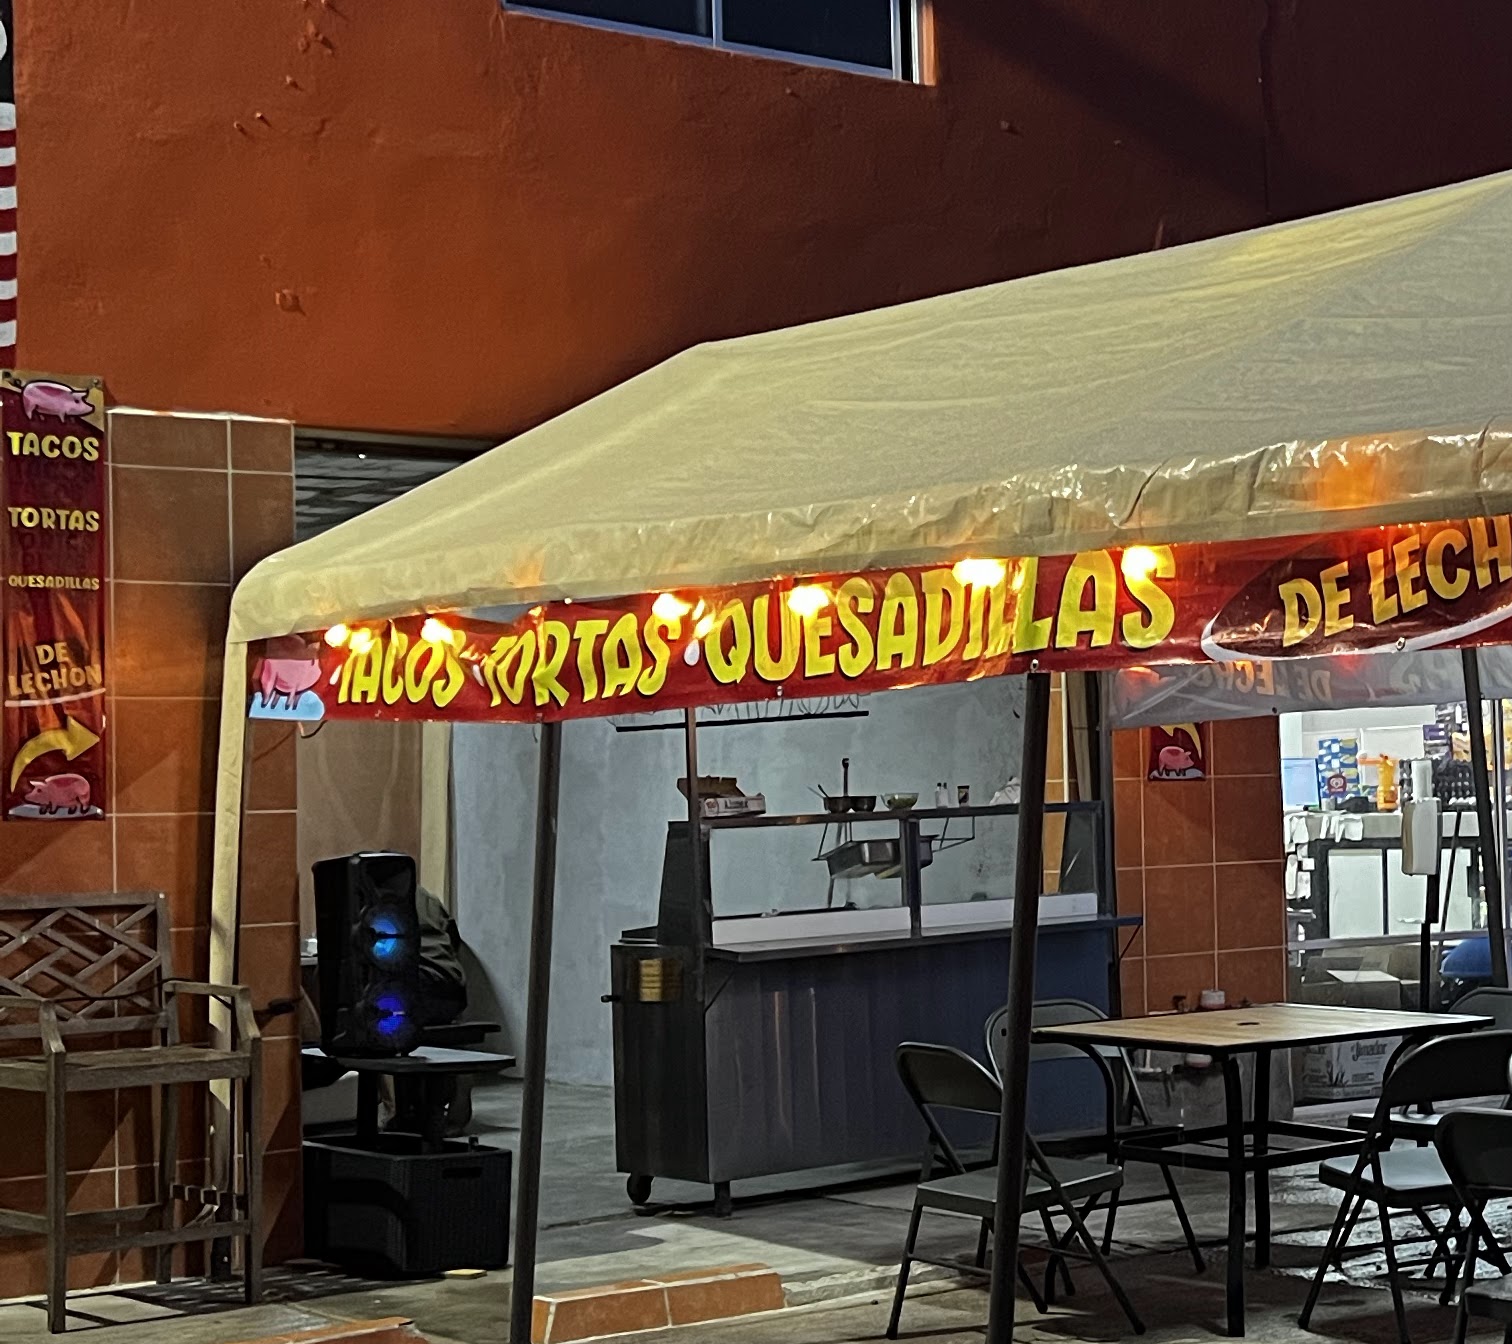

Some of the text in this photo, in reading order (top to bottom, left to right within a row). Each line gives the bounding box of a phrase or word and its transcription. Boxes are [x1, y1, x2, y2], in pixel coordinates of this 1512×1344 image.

[6, 431, 99, 461] TACOS
[8, 507, 100, 532] TORTAS
[8, 575, 100, 591] QUESADILLAS
[336, 628, 466, 708] TACOS
[482, 613, 683, 708] TORTAS
[704, 544, 1177, 684] QUESADILLAS
[1278, 561, 1355, 648] DE
[35, 642, 69, 666] DE
[8, 664, 102, 696] LECHON
